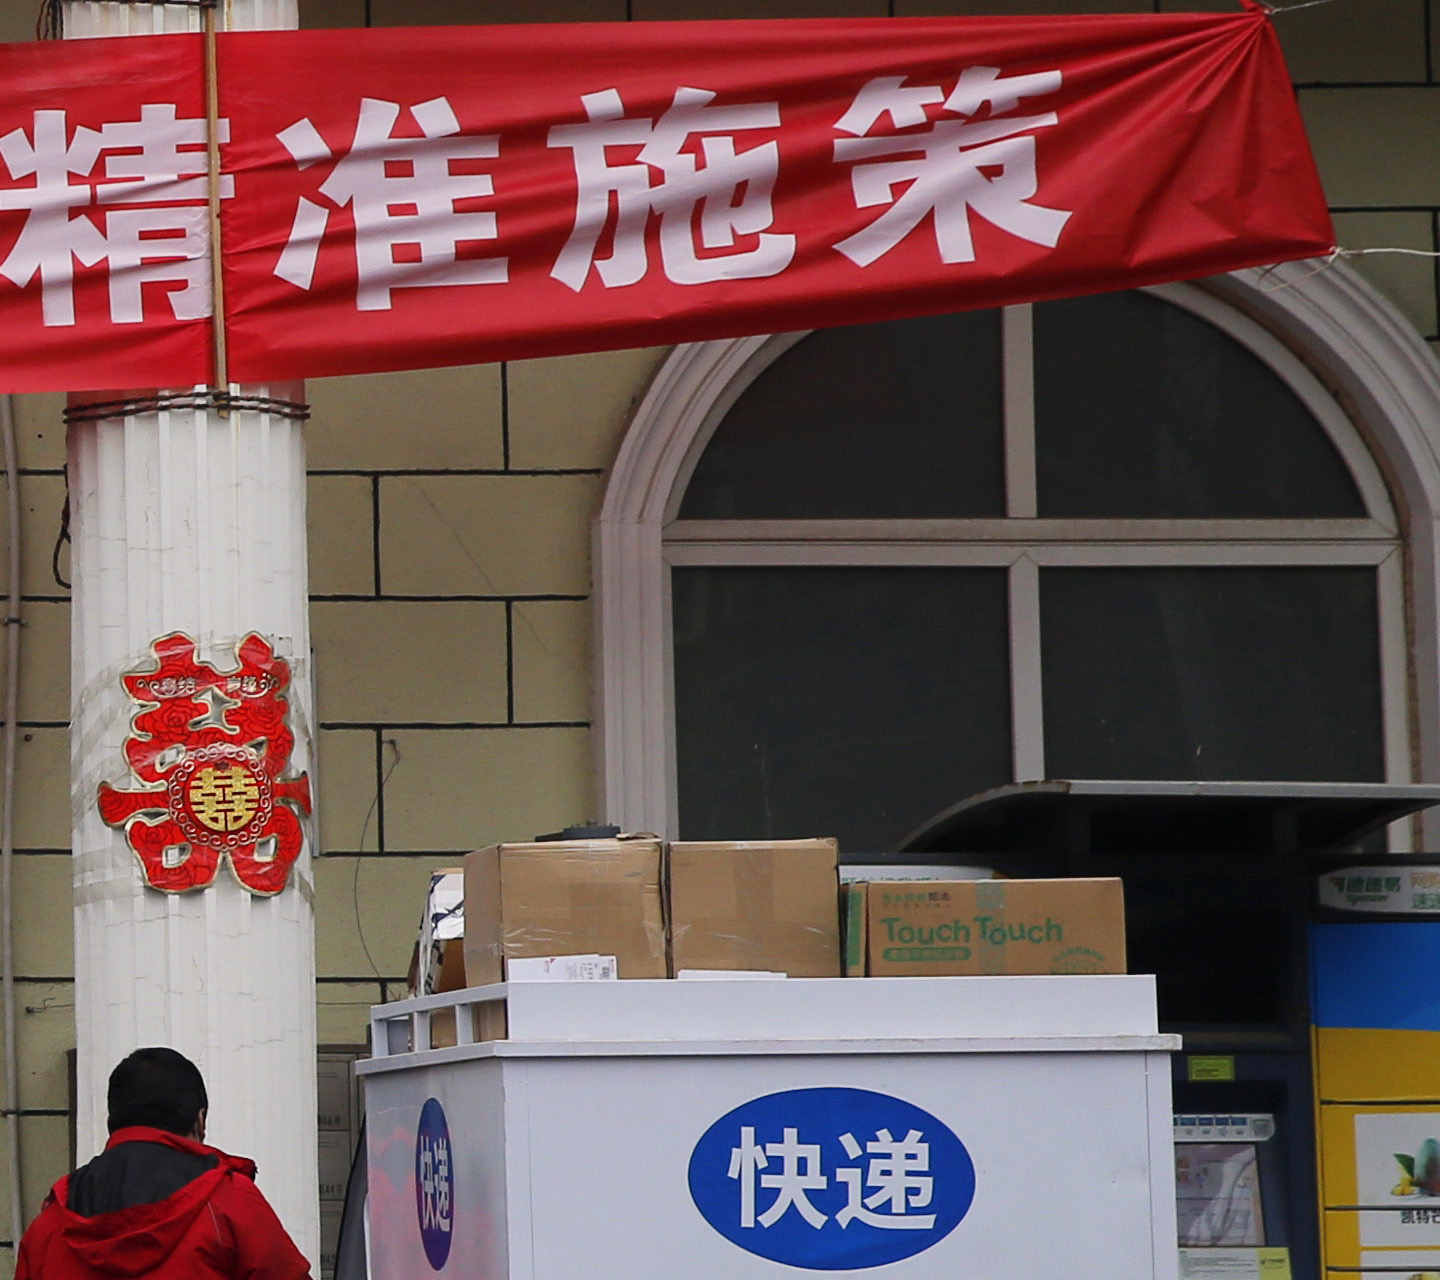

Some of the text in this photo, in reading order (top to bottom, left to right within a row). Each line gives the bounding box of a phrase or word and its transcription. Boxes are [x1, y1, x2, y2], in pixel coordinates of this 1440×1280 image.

[879, 916, 1064, 946] Touch Touch
[419, 1134, 451, 1233] 快递
[727, 1125, 938, 1231] 快递
